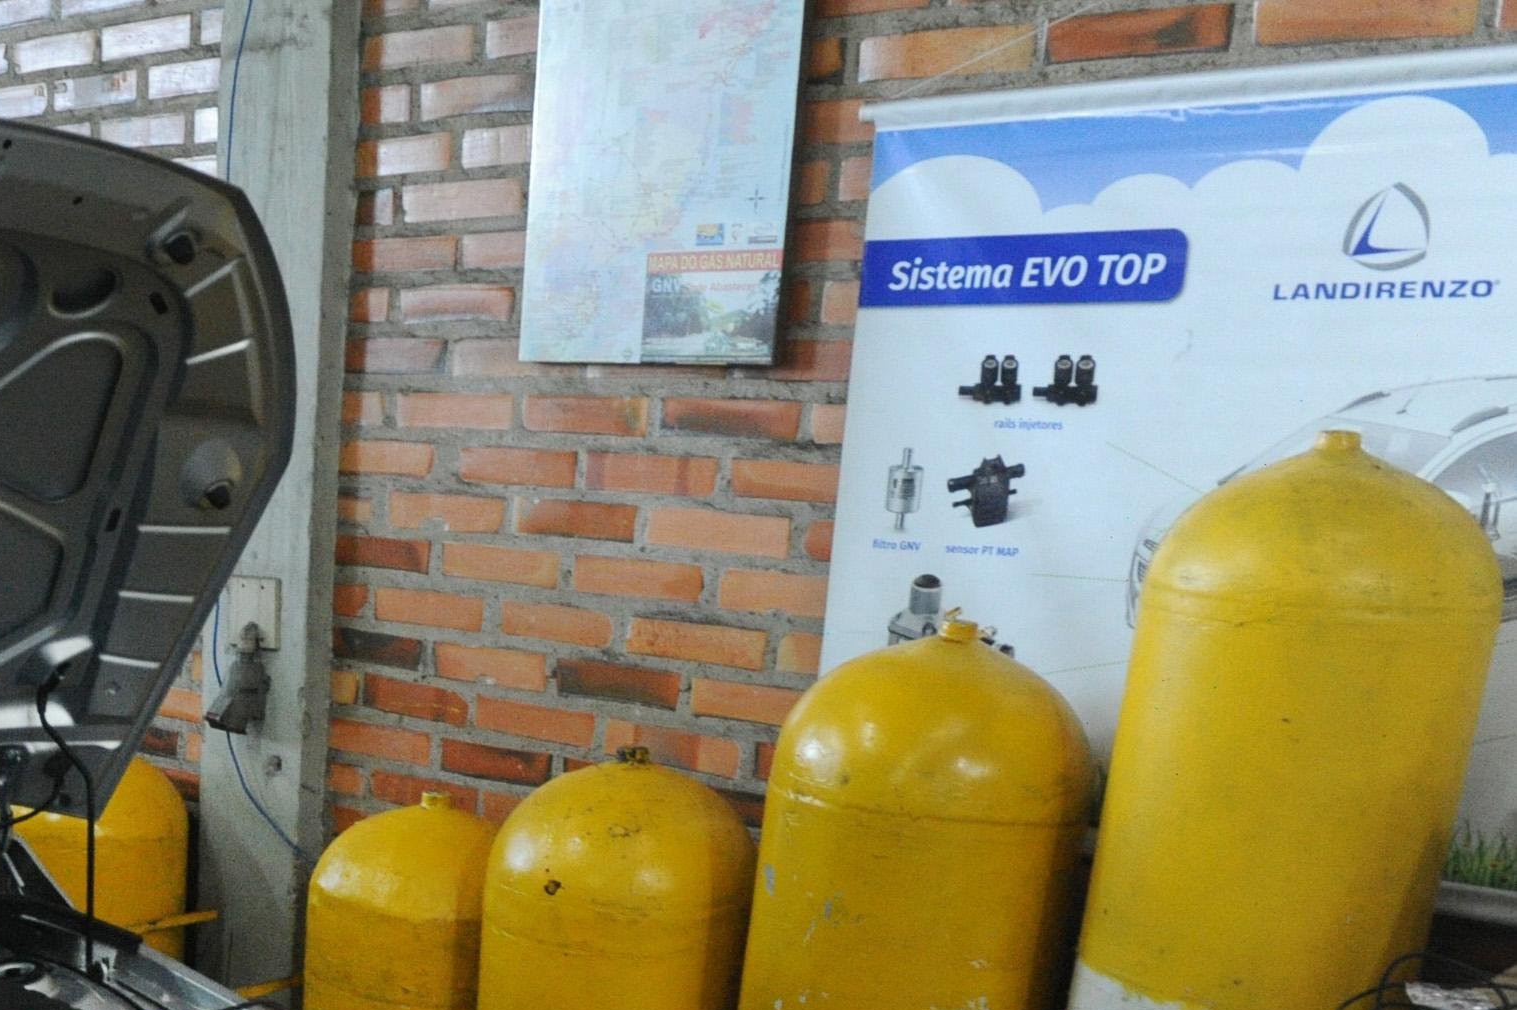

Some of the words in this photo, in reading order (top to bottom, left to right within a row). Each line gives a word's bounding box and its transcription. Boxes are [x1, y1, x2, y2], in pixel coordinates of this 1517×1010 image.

[649, 255, 678, 272] MAPA
[681, 255, 698, 271] DO
[726, 252, 779, 270] NATURAL
[888, 256, 1014, 291] Sistema
[1020, 254, 1088, 288] EVO
[1097, 252, 1167, 286] TOP
[994, 418, 1016, 430] rails
[1019, 418, 1064, 431] injetores
[872, 538, 898, 551] filtro
[900, 540, 922, 551] GNV
[945, 544, 980, 555] sensor
[982, 545, 995, 555] PT
[997, 546, 1019, 558] MAP
